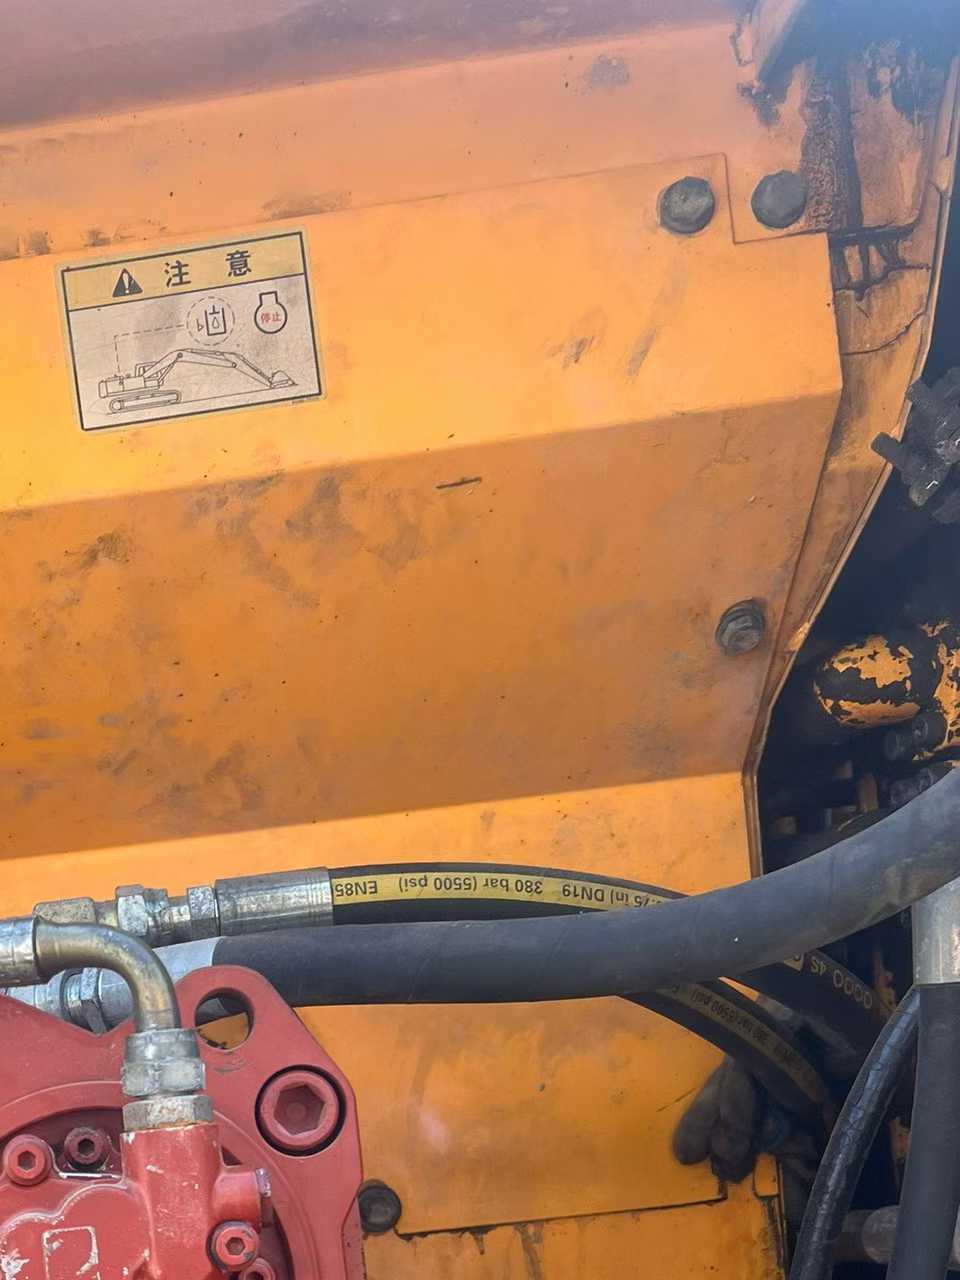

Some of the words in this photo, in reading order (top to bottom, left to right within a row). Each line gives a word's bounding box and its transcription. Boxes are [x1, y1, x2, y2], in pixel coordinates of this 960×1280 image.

[164, 249, 252, 288] 注意
[260, 311, 282, 324] 停止
[398, 875, 428, 893] psi)
[433, 876, 478, 891] (5500
[483, 878, 509, 892] bar
[514, 879, 543, 894] 380
[562, 883, 605, 902] DN19
